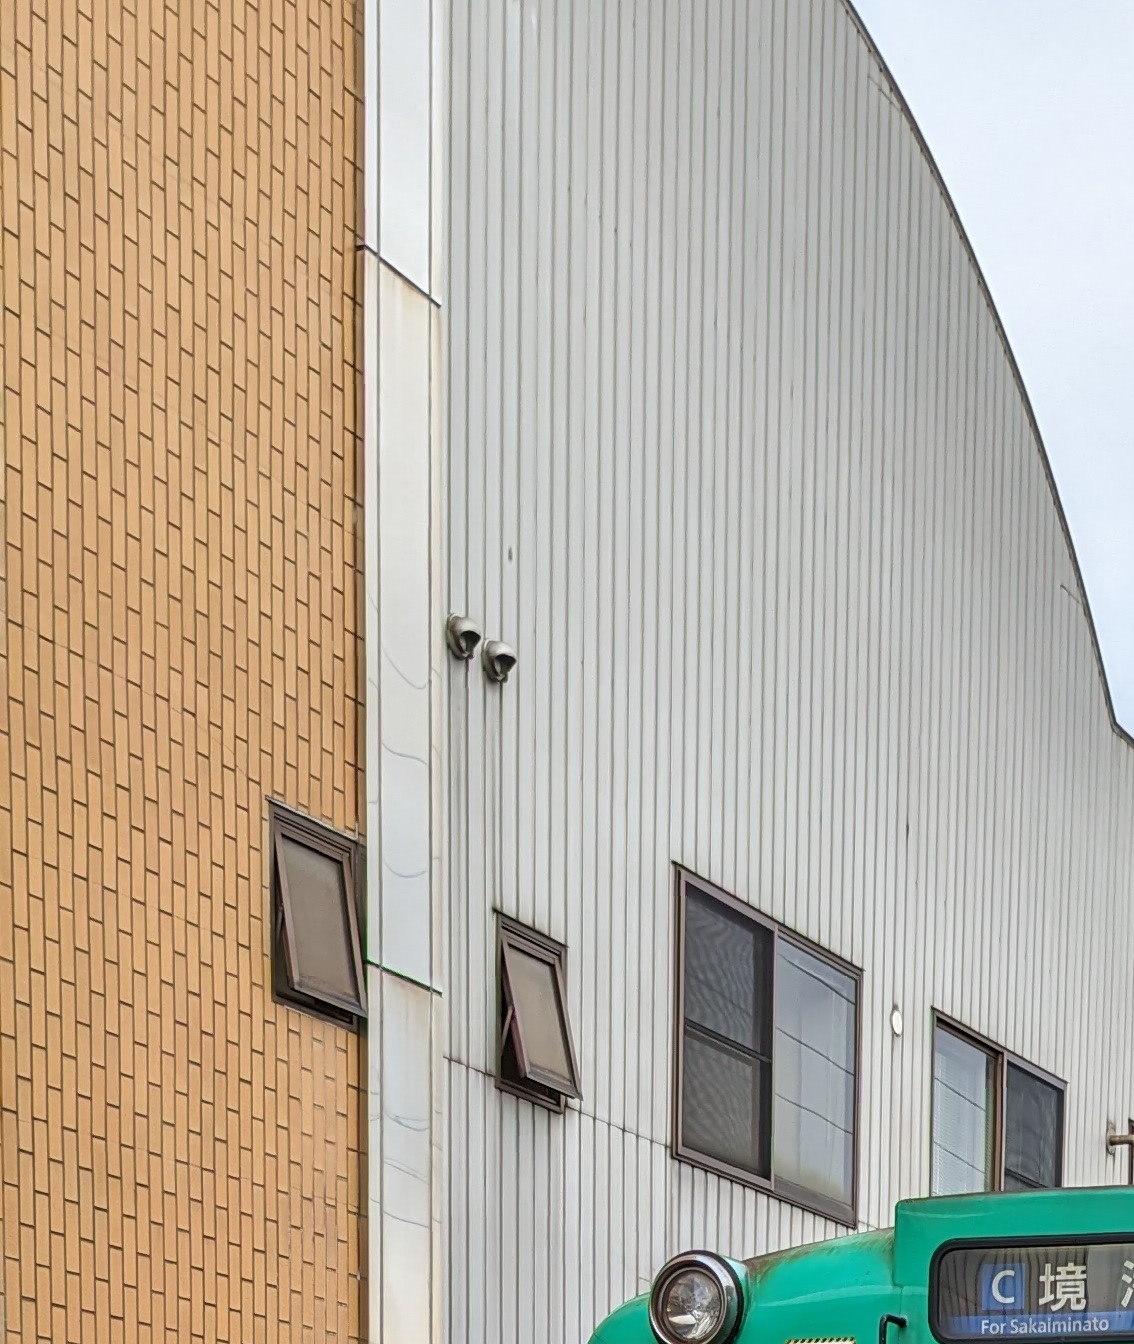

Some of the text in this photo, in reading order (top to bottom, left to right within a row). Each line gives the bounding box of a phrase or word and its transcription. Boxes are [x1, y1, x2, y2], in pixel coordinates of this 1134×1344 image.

[991, 1269, 1015, 1304] C
[980, 1316, 1110, 1336] For Sakaiminato
